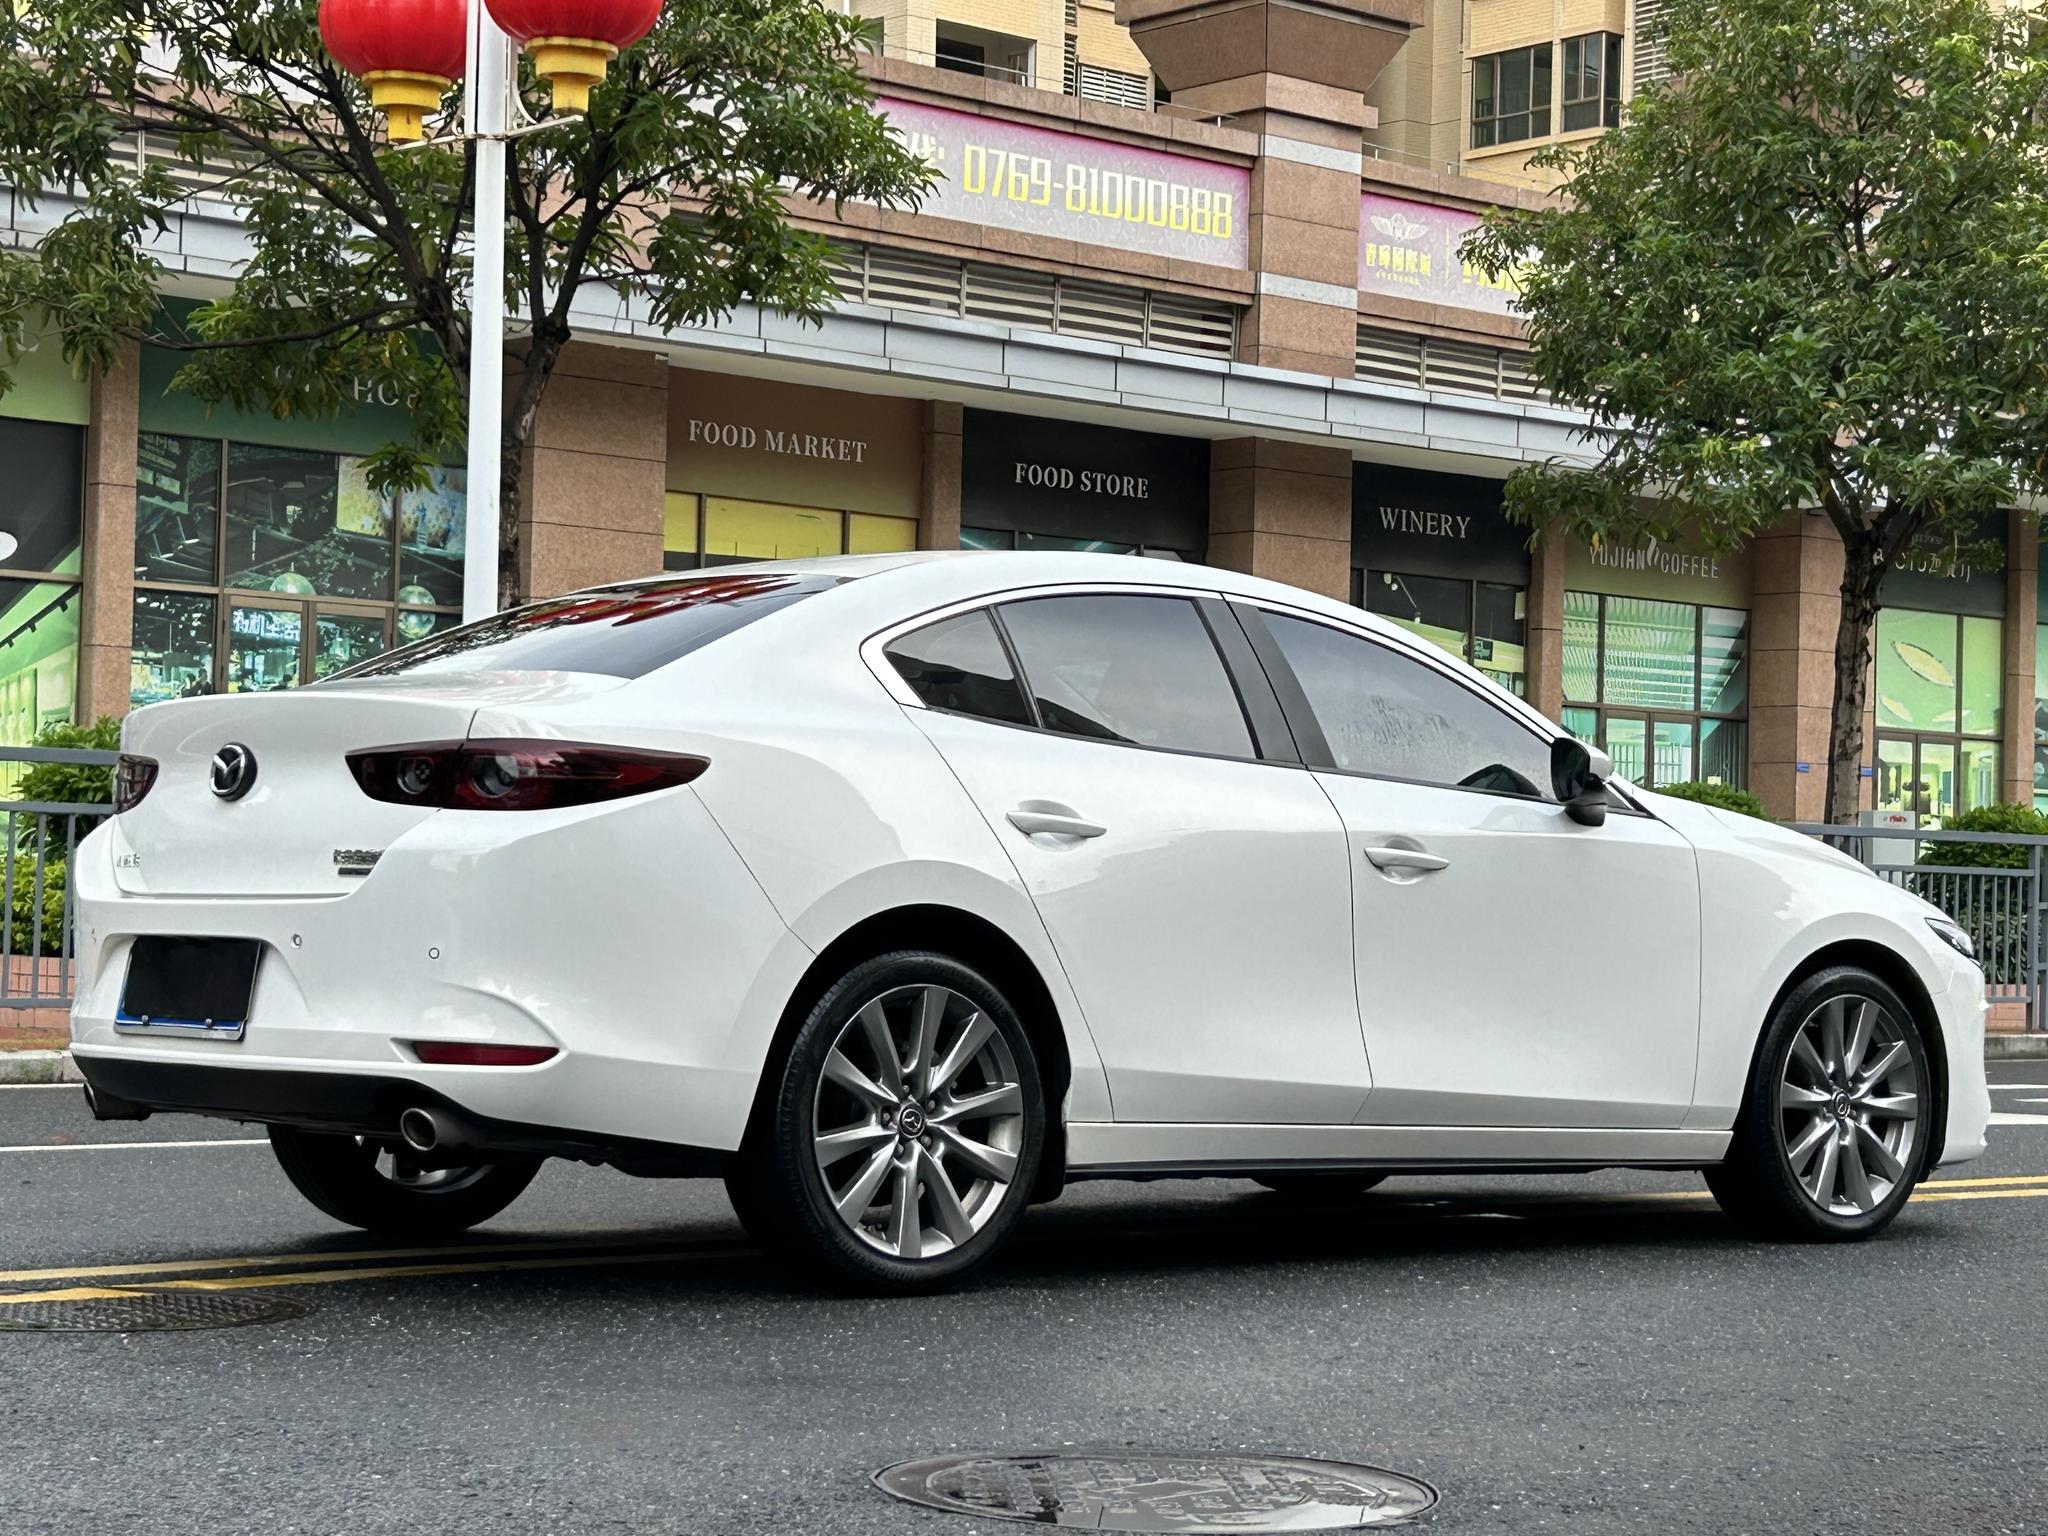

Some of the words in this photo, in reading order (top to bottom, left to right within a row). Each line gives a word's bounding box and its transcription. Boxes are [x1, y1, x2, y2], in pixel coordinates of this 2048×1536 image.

[962, 143, 1233, 239] 0769-81000888
[688, 419, 756, 449] FOOD
[764, 429, 867, 463] MARKET
[1015, 462, 1074, 489] FOOD
[1080, 470, 1149, 499] STORE
[1379, 506, 1471, 539] WINERY
[1589, 544, 1646, 571] YUJIAN
[1659, 551, 1719, 579] COFFEE
